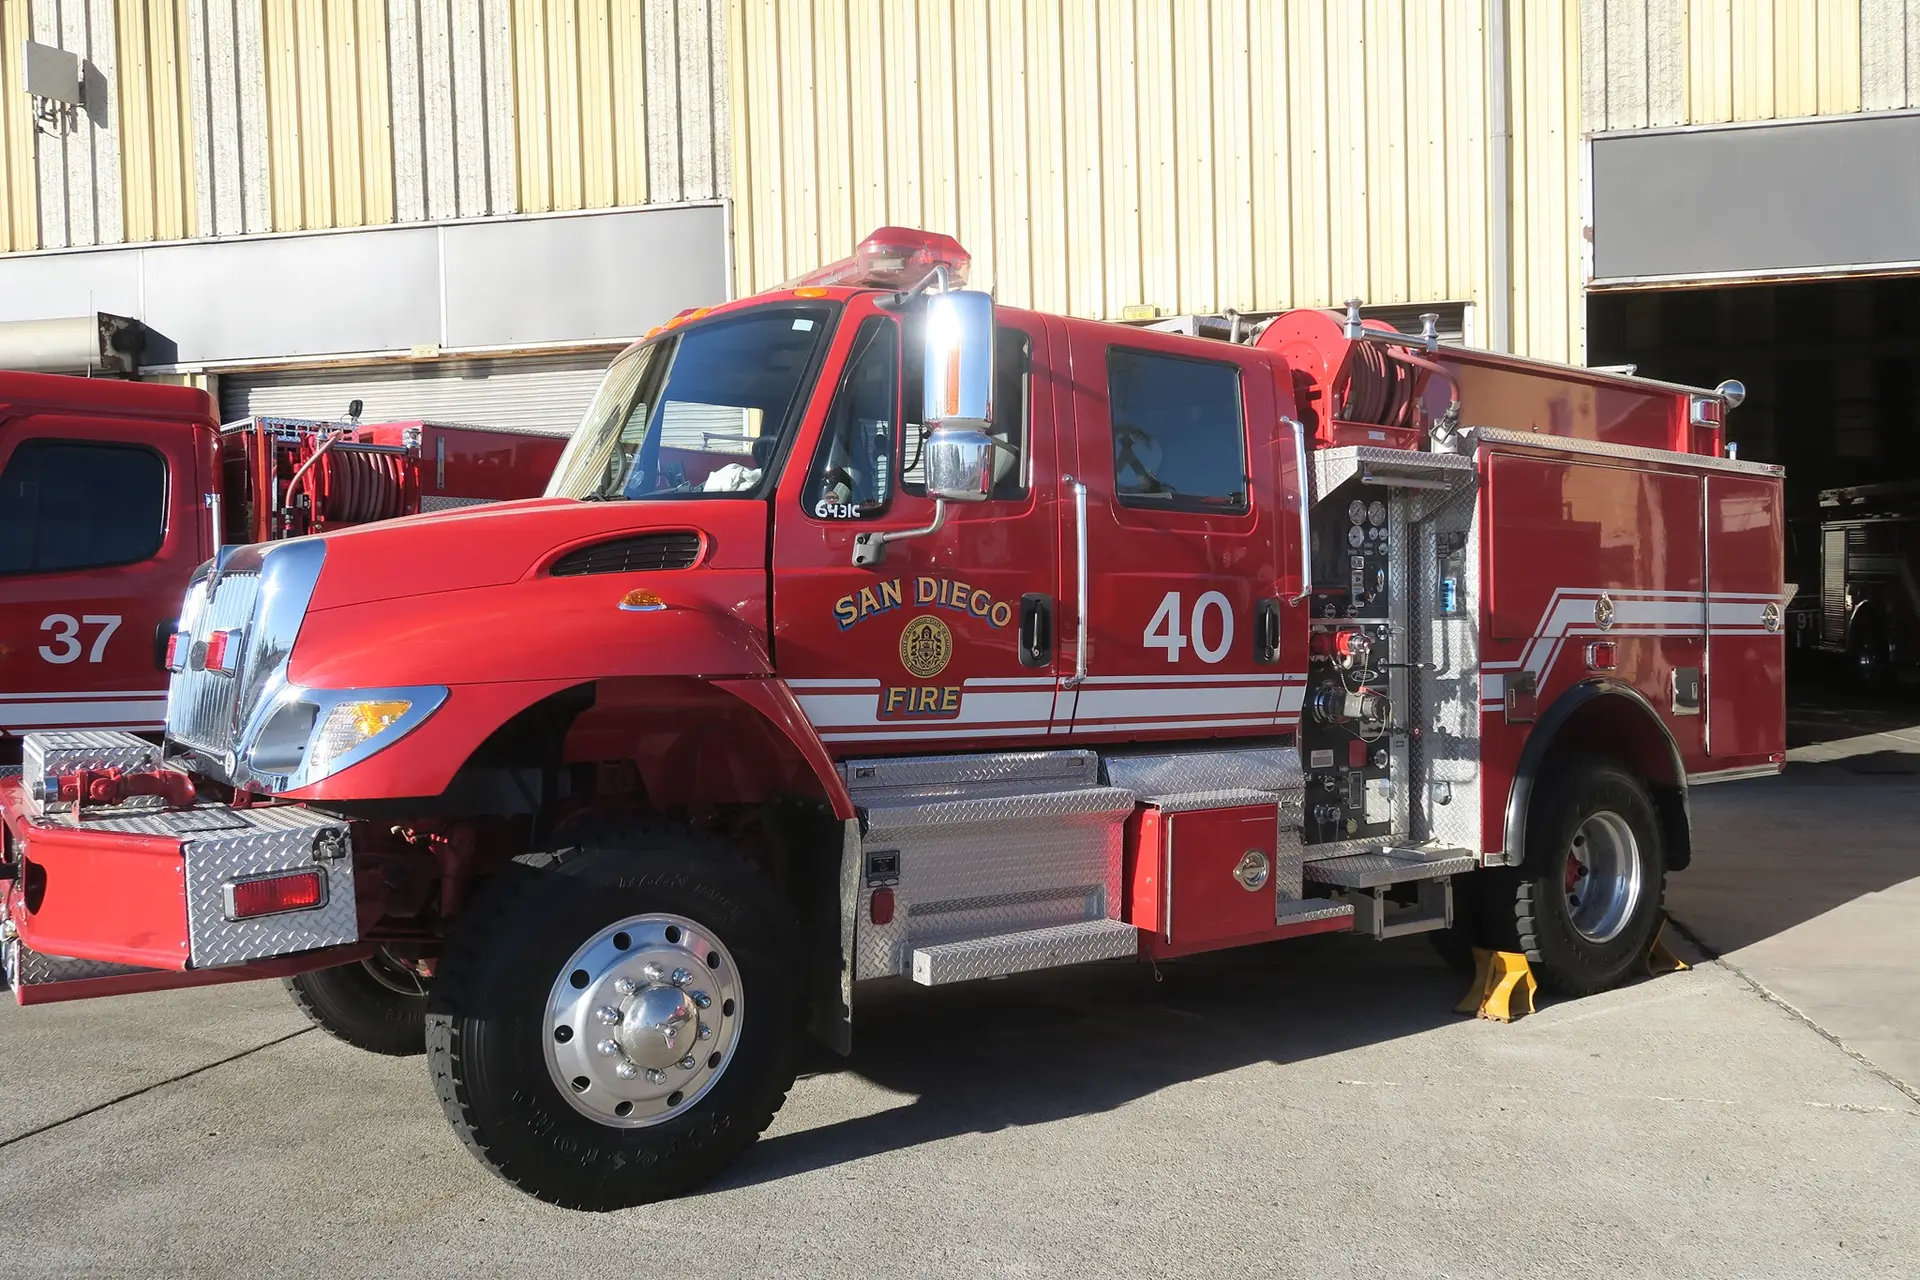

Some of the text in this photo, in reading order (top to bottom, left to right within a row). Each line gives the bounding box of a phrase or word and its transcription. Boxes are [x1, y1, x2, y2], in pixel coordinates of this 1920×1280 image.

[833, 577, 1012, 631] SAN DIEGO
[1143, 590, 1234, 664] 40
[38, 613, 122, 664] 37
[884, 685, 961, 716] FIRE
